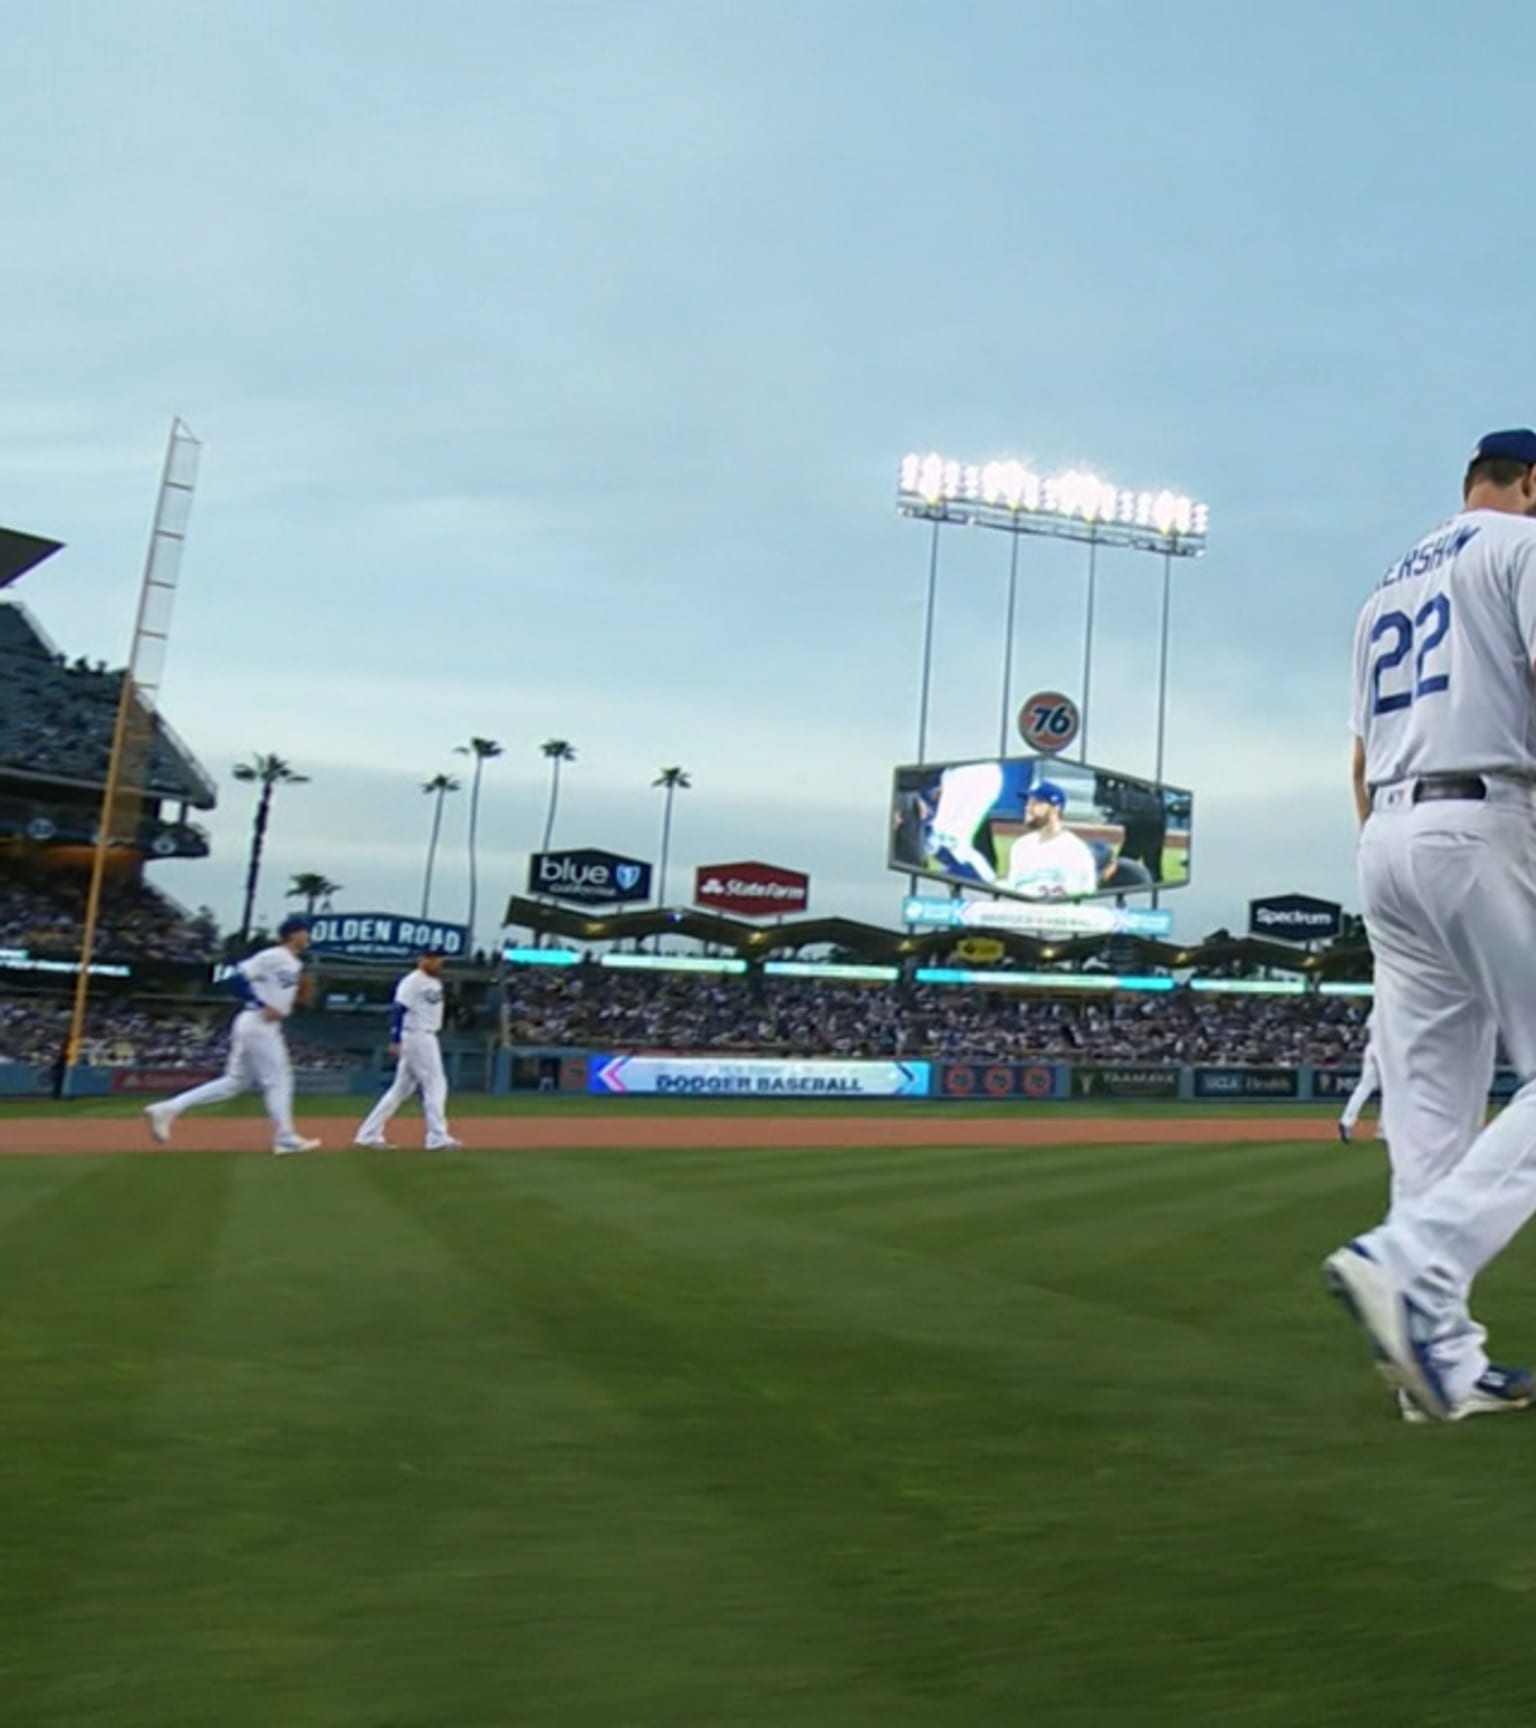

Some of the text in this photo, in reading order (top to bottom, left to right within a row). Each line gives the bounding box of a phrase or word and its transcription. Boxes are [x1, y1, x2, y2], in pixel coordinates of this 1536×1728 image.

[1377, 525, 1481, 589] ERSHAW
[1371, 591, 1451, 716] 22
[1033, 706, 1070, 735] 76
[539, 857, 609, 884] blue
[1256, 907, 1332, 925] Spectrum
[310, 918, 461, 954] OLDEN ROAD
[656, 1074, 863, 1092] DODGER BASEBALL
